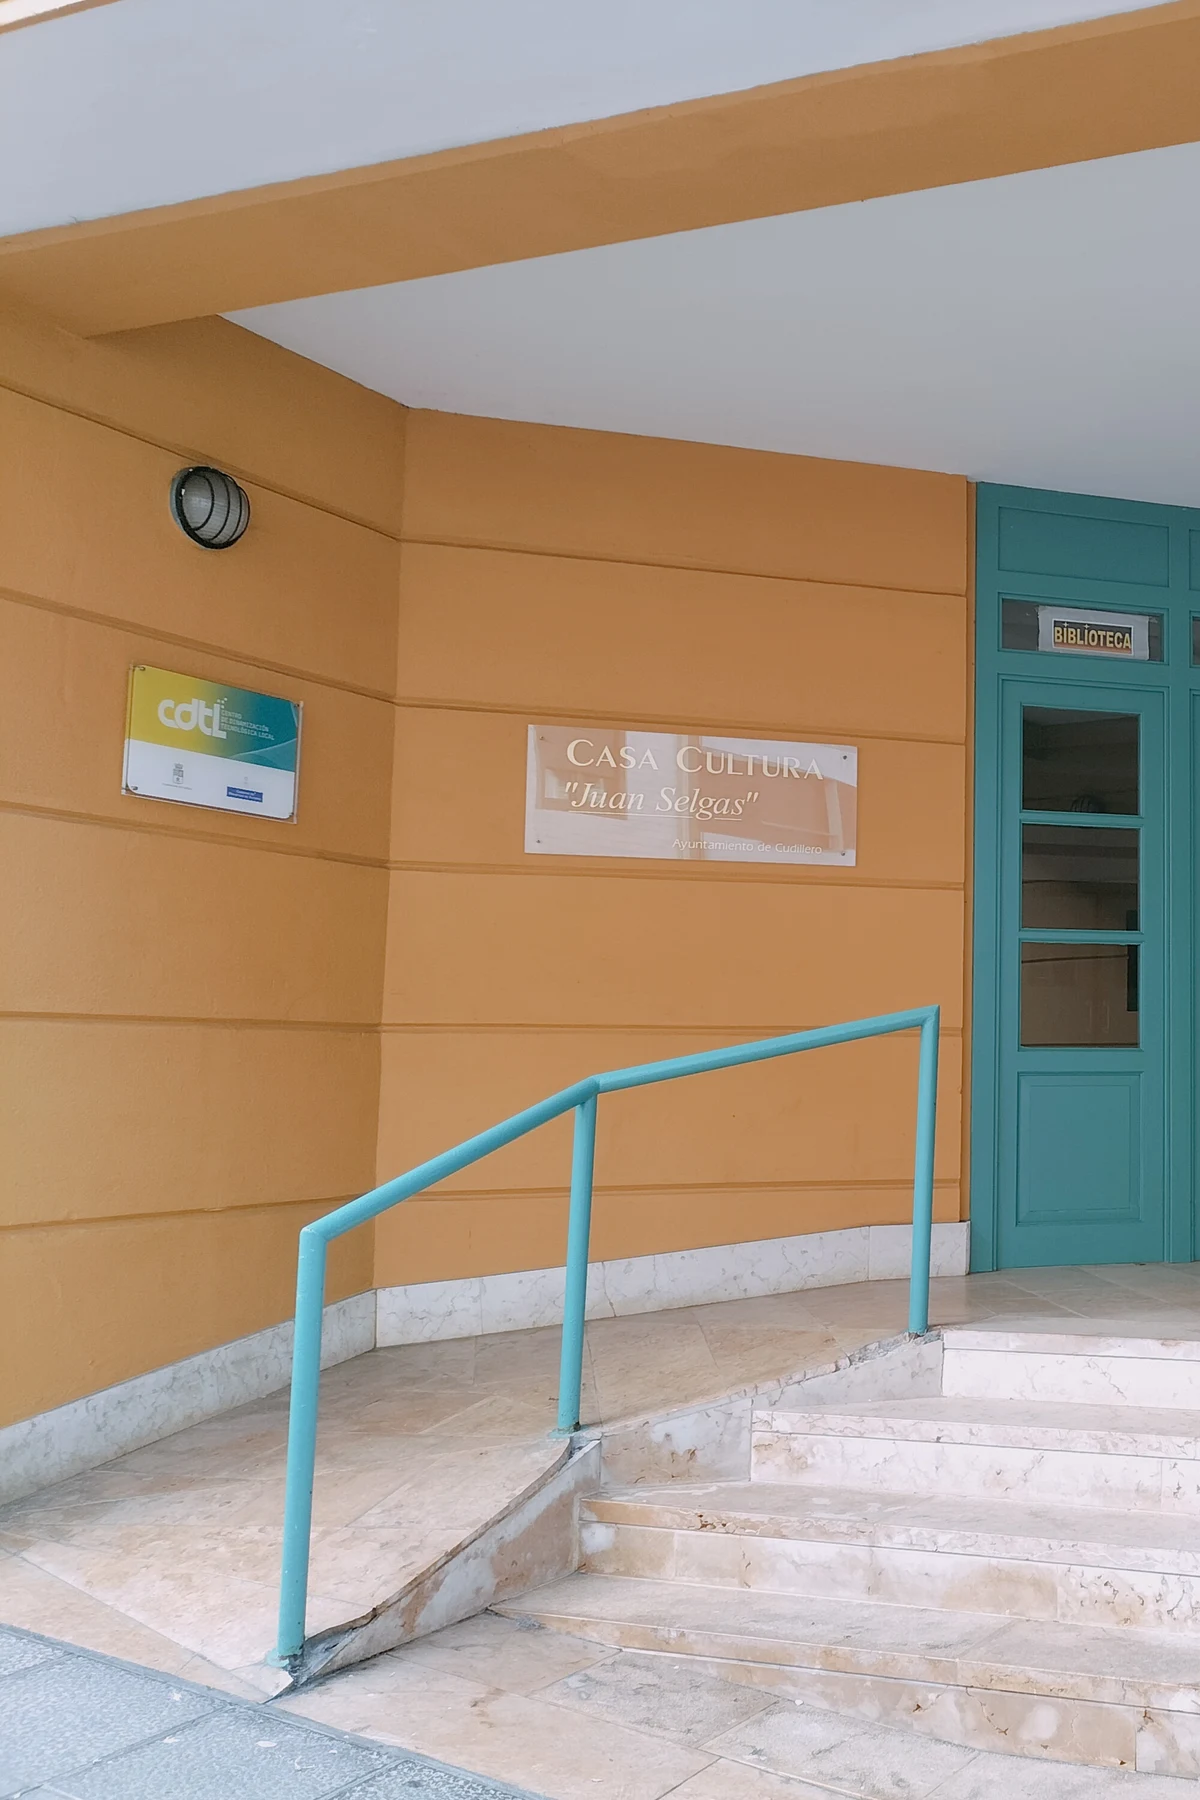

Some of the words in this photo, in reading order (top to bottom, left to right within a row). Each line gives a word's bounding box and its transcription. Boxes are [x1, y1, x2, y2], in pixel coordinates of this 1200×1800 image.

[1054, 622, 1132, 649] BIBLIOTECA
[258, 731, 275, 741] LOCAL
[566, 739, 659, 770] CASA
[676, 745, 824, 780] CULTURA
[565, 781, 645, 809] "Juan
[655, 786, 760, 821] Selgas"
[672, 838, 754, 852] Ayuntamiento
[757, 840, 772, 853] de
[775, 842, 823, 856] Cudillero
